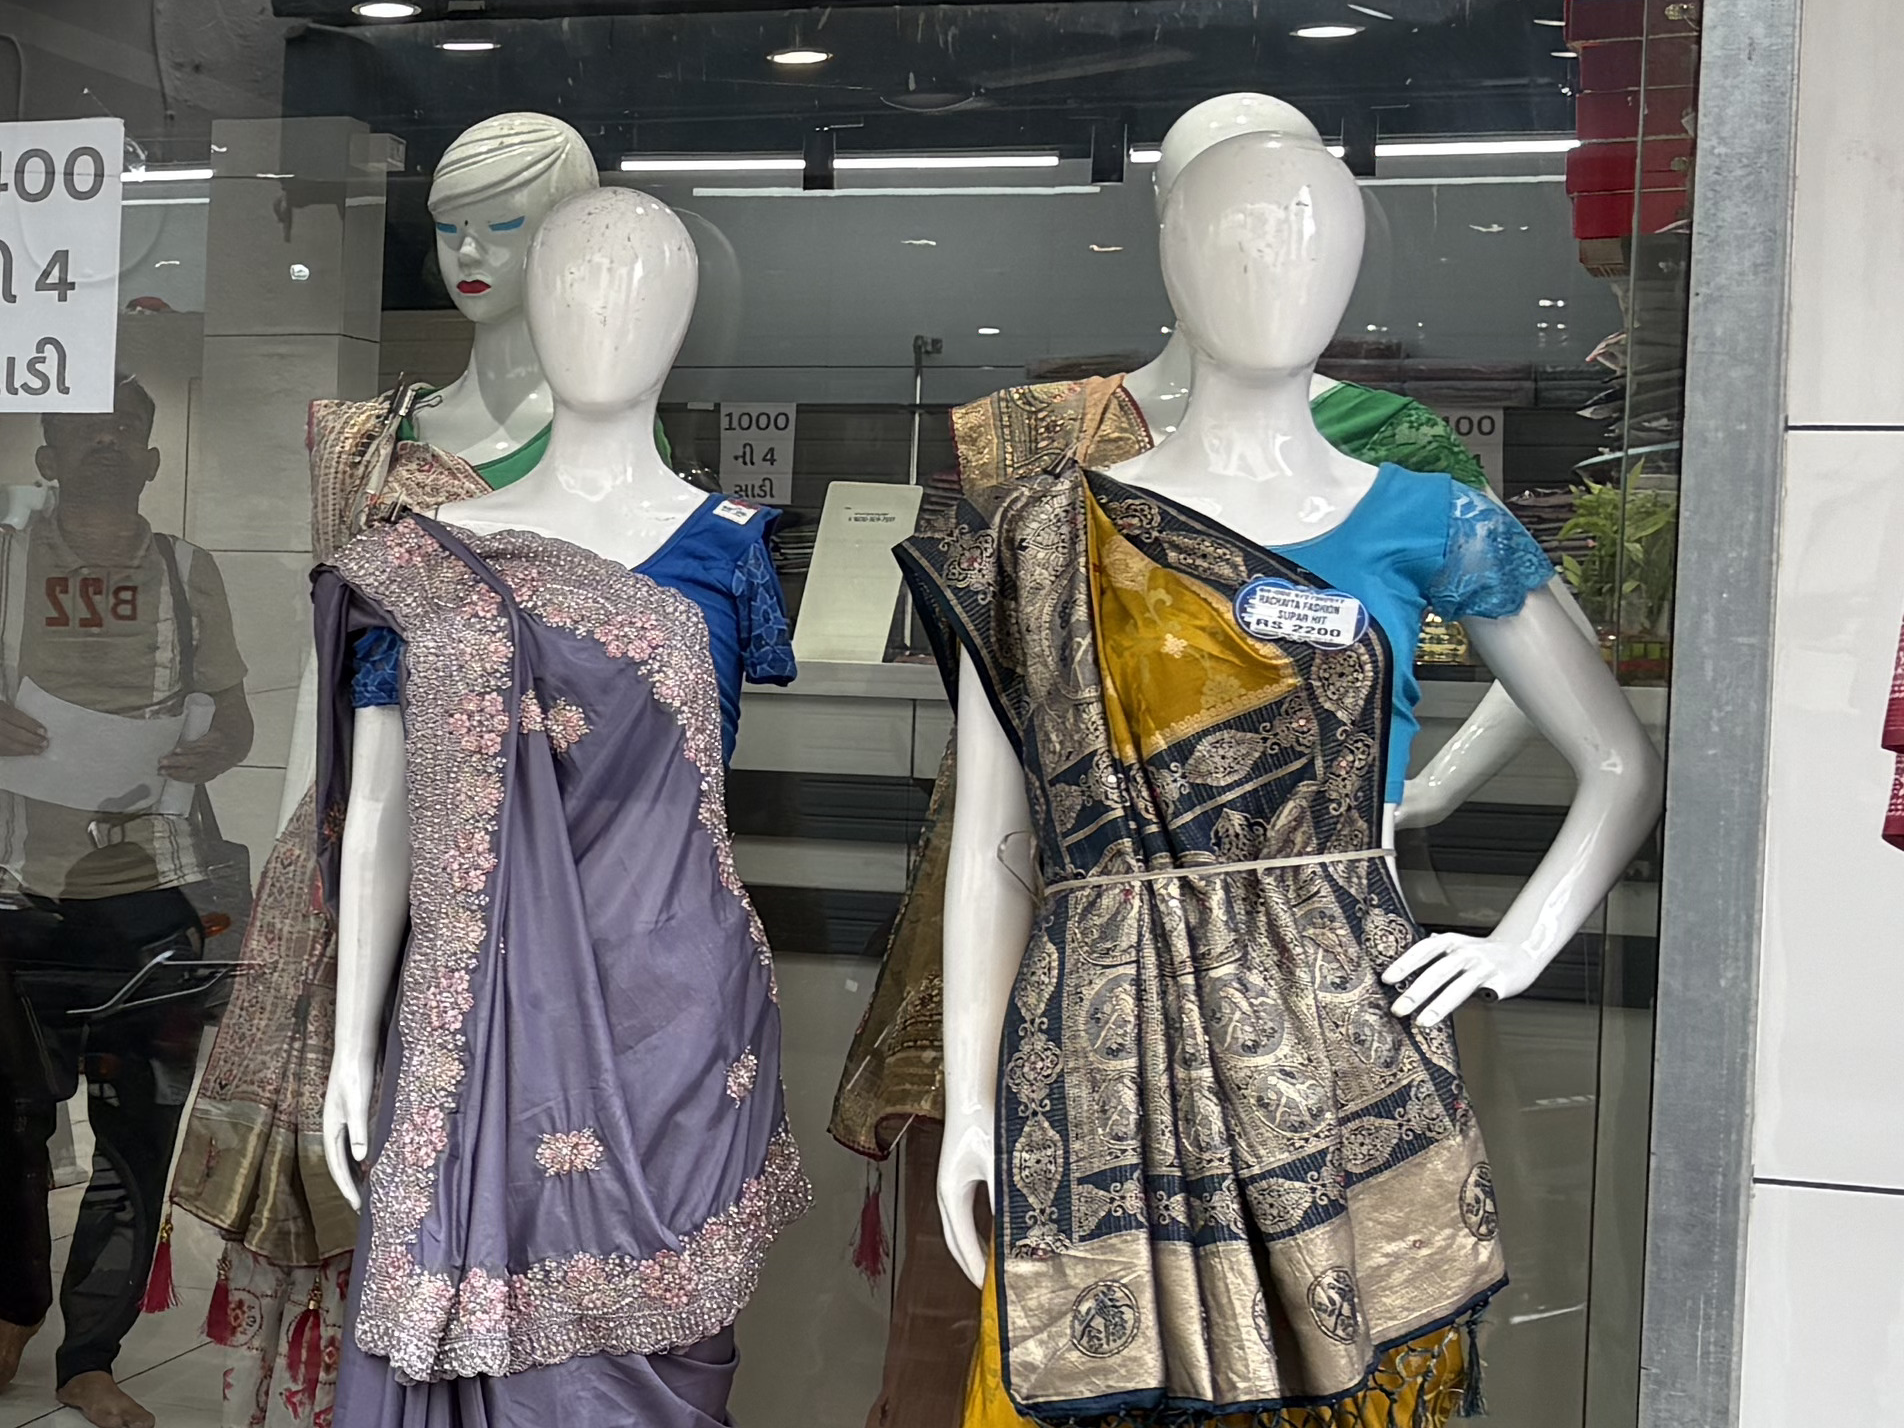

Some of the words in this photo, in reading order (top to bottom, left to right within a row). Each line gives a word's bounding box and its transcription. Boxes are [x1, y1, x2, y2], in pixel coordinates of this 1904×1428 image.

[34, 249, 76, 303] 4
[723, 412, 790, 431] 1000
[733, 442, 755, 466] ની
[762, 447, 777, 466] 4
[733, 477, 775, 498] સાડી
[1292, 624, 1341, 637] 2200
